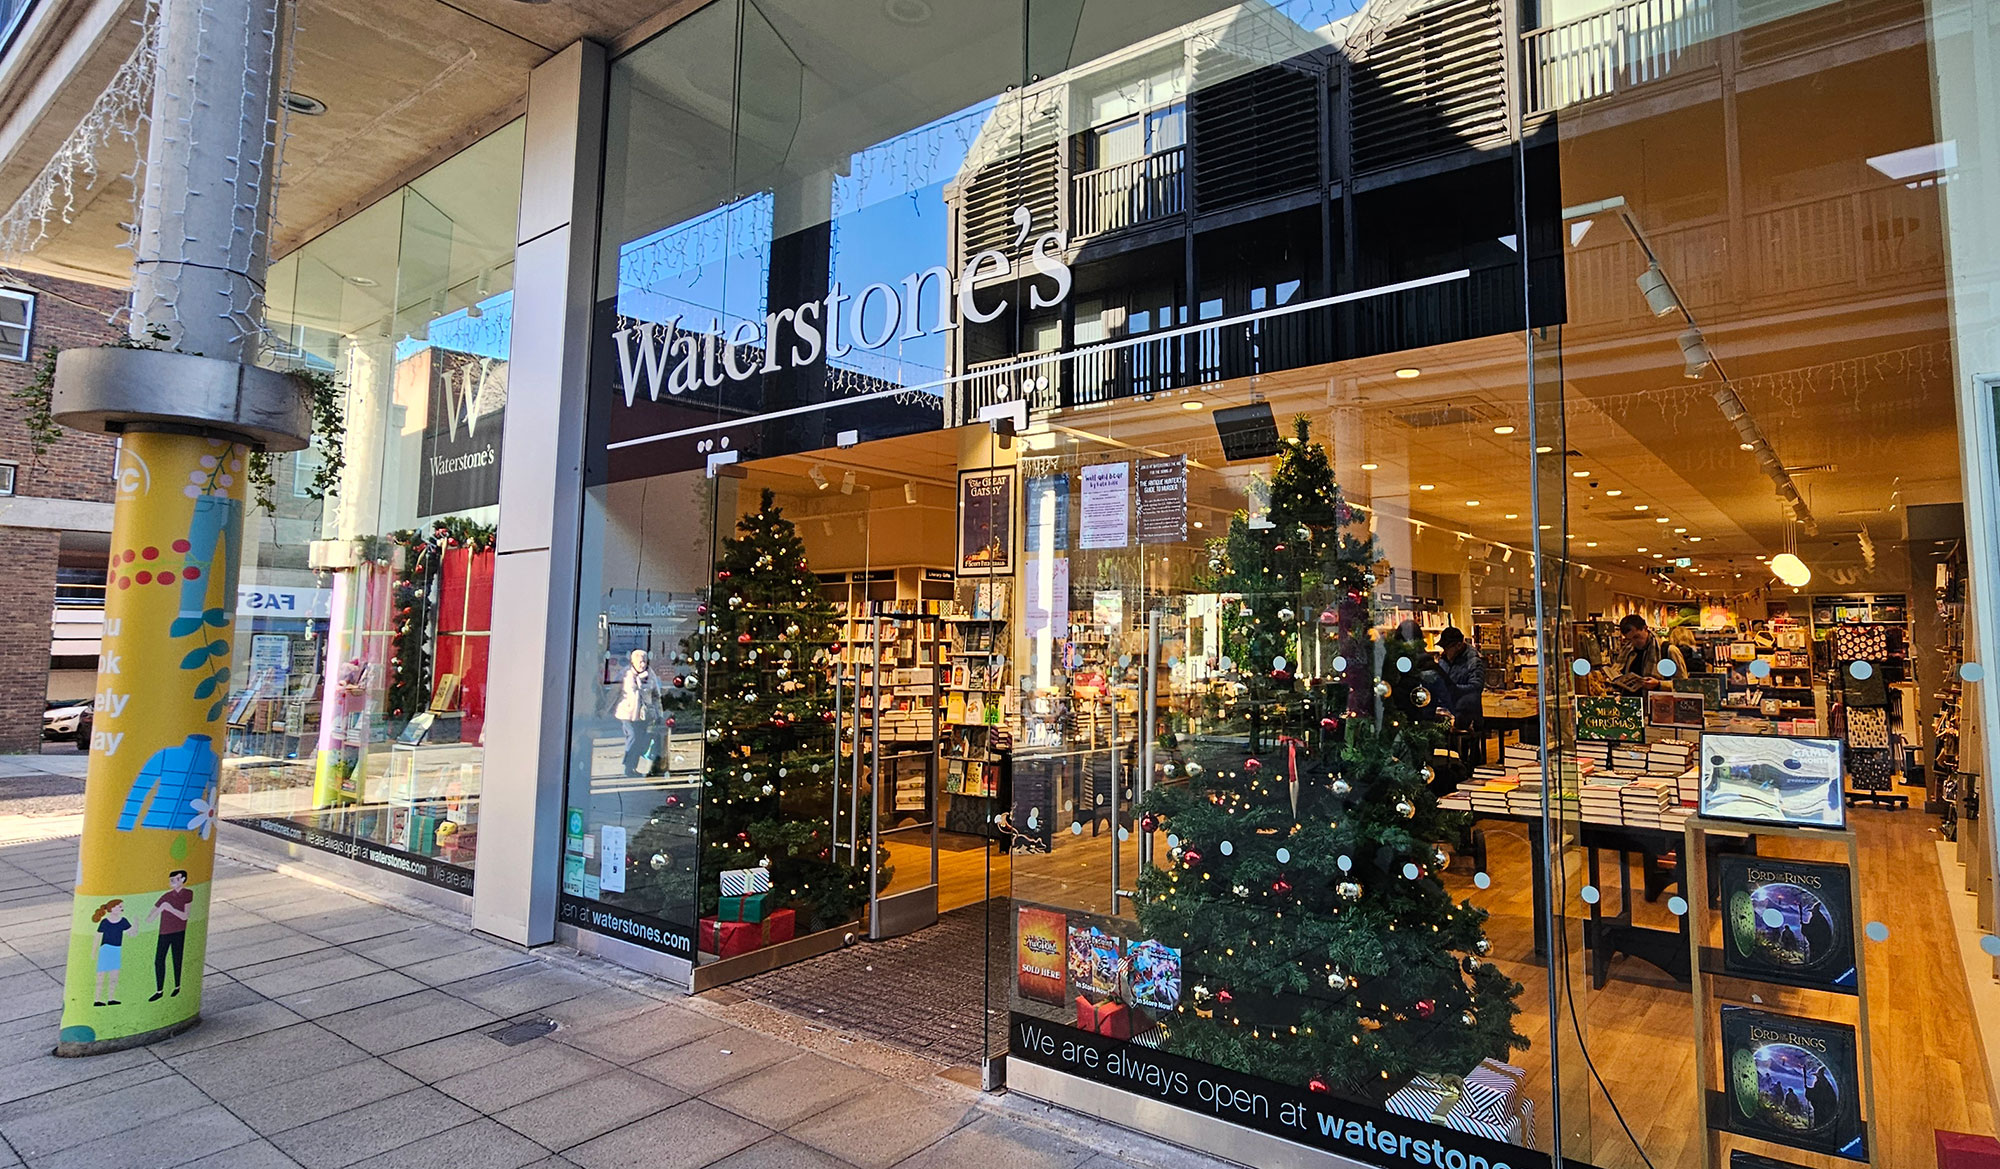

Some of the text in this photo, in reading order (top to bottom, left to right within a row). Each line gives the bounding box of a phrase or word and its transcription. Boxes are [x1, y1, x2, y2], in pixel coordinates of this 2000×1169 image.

[612, 205, 1071, 408] Waterstone's
[441, 358, 491, 443] W
[430, 443, 495, 477] Waterstone's
[642, 601, 677, 617] Collect
[1586, 716, 1638, 730] CHRISTMAS
[369, 849, 427, 876] waterstones.com
[1747, 867, 1776, 883] LORD
[1785, 872, 1822, 889] RINGS
[580, 907, 590, 923] at
[592, 911, 690, 952] waterstones.com
[1021, 963, 1061, 980] SOLD HERE
[1136, 997, 1174, 1011] In Store Now!
[1749, 1025, 1779, 1042] LORD
[1788, 1032, 1826, 1053] RINGS
[1020, 1022, 1055, 1055] We
[1061, 1041, 1099, 1068] are
[1106, 1049, 1189, 1095] always
[1197, 1079, 1269, 1119] open
[1279, 1101, 1307, 1131] at
